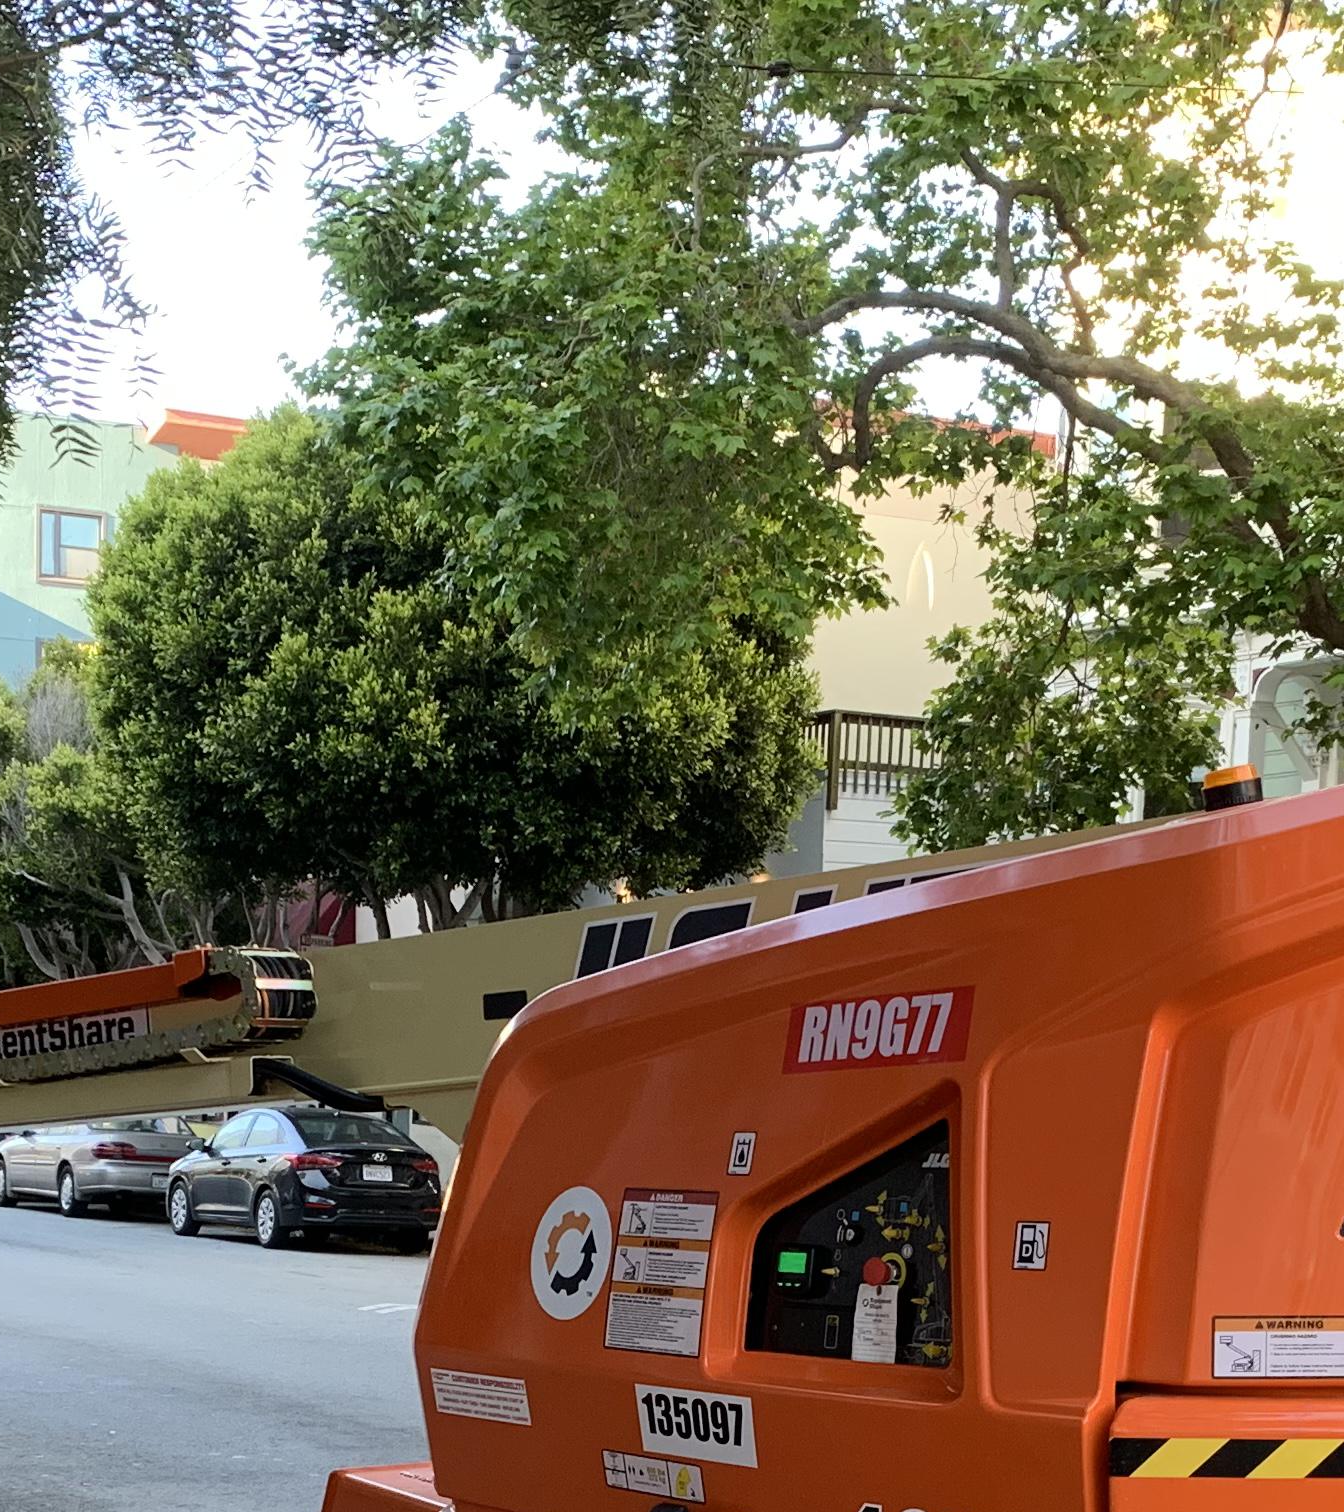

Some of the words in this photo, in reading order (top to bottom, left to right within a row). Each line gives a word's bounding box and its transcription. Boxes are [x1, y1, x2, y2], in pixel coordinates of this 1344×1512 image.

[798, 991, 954, 1064] RN9G77
[921, 1152, 950, 1169] JLG
[655, 1193, 684, 1203] DANGER
[1266, 1320, 1324, 1330] WARNING
[641, 1392, 743, 1447] 135097
